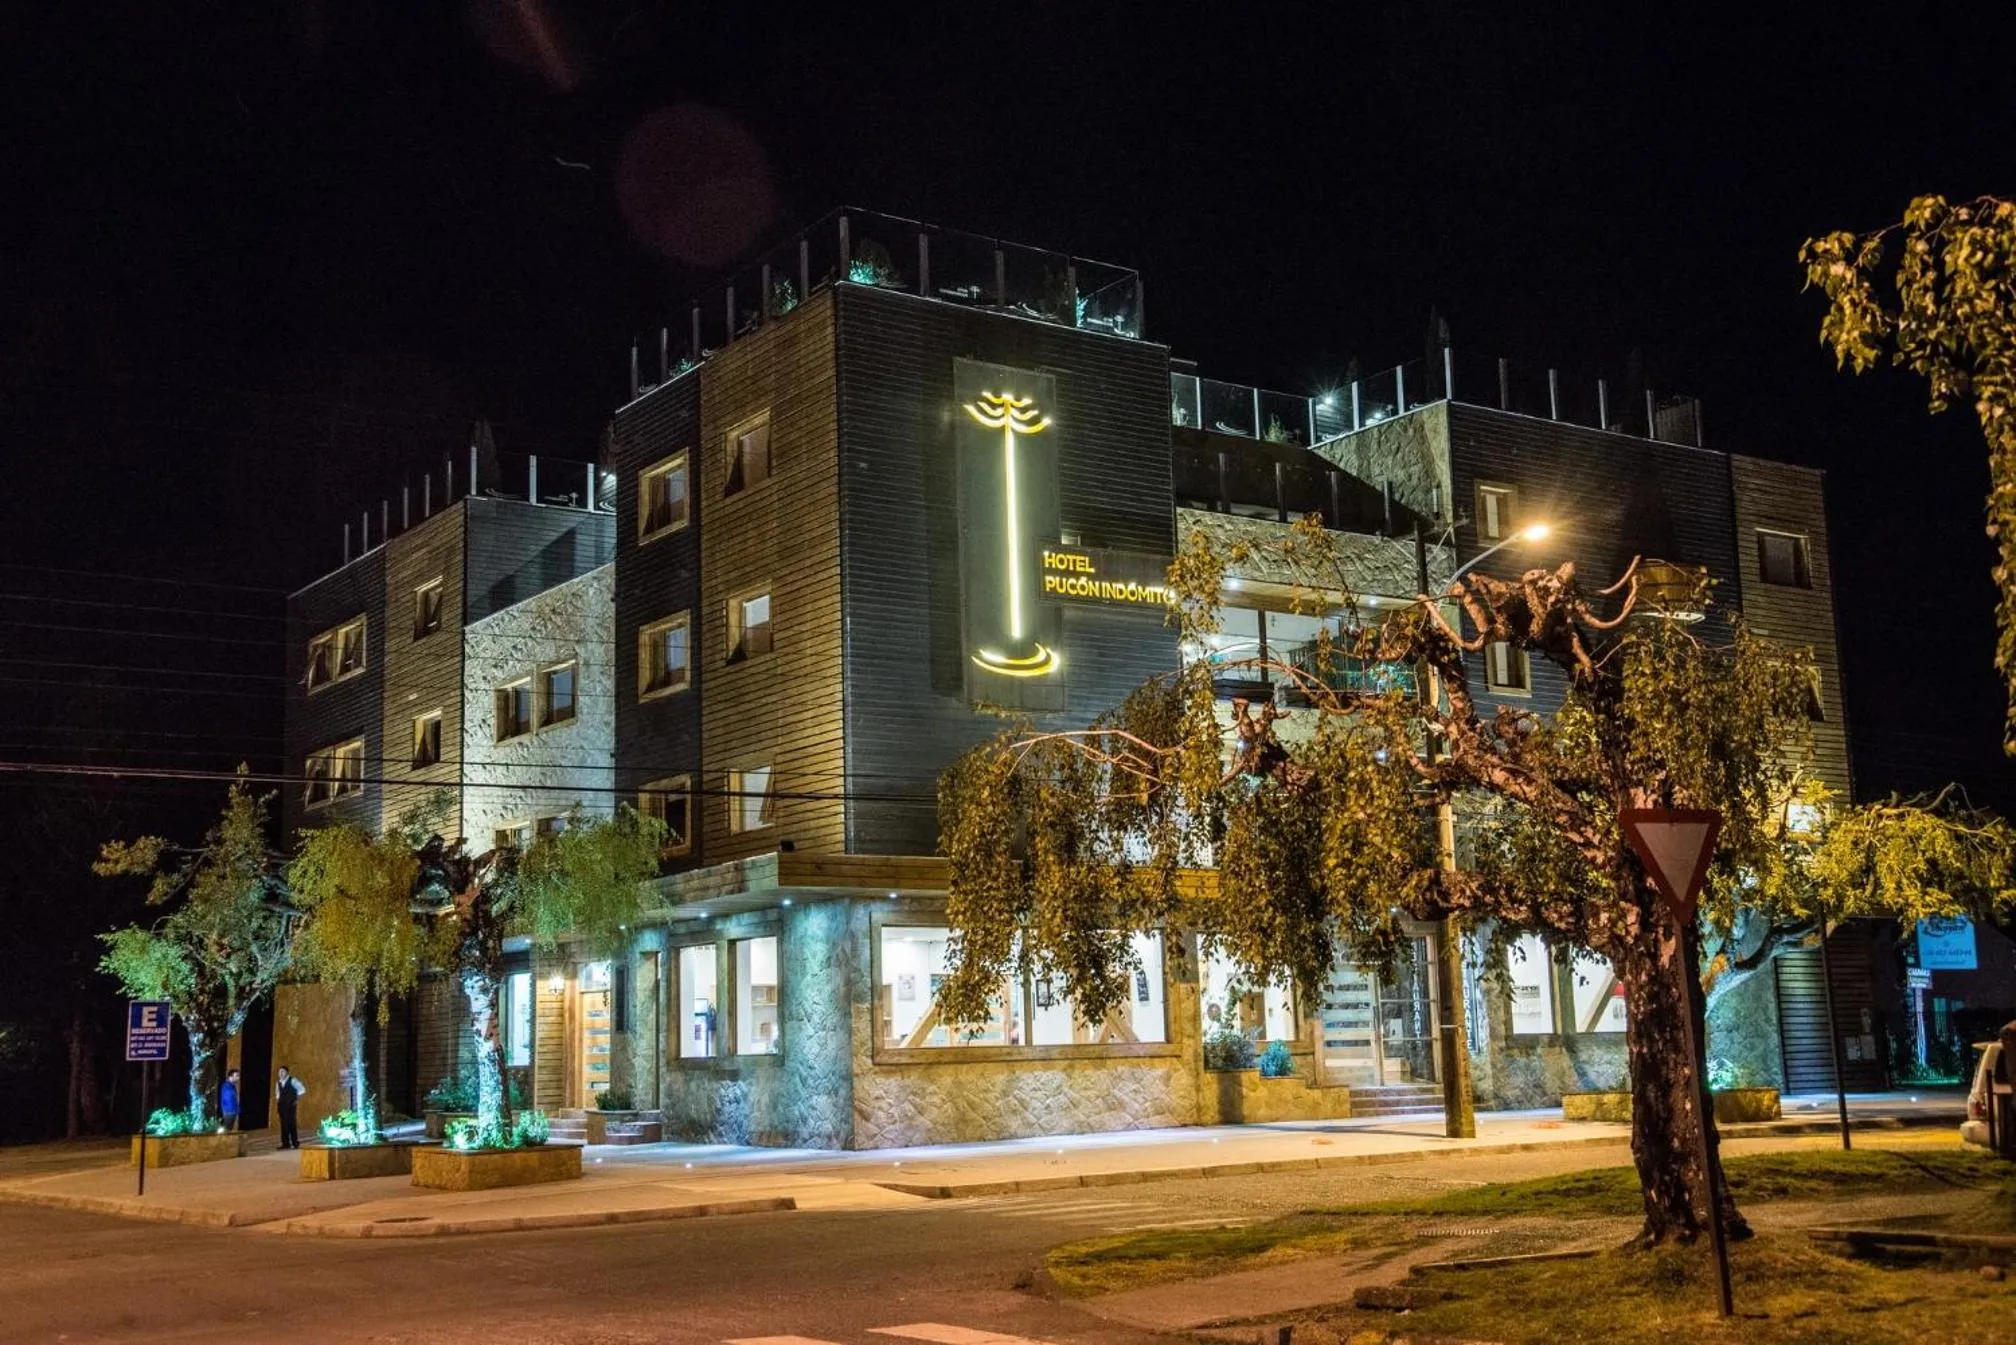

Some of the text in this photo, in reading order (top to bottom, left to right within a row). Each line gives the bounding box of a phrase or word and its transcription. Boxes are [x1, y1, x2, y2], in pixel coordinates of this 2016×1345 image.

[1043, 550, 1095, 573] HOTEL
[1044, 575, 1177, 605] PUCÓN INDÓMITO
[142, 1006, 158, 1027] E
